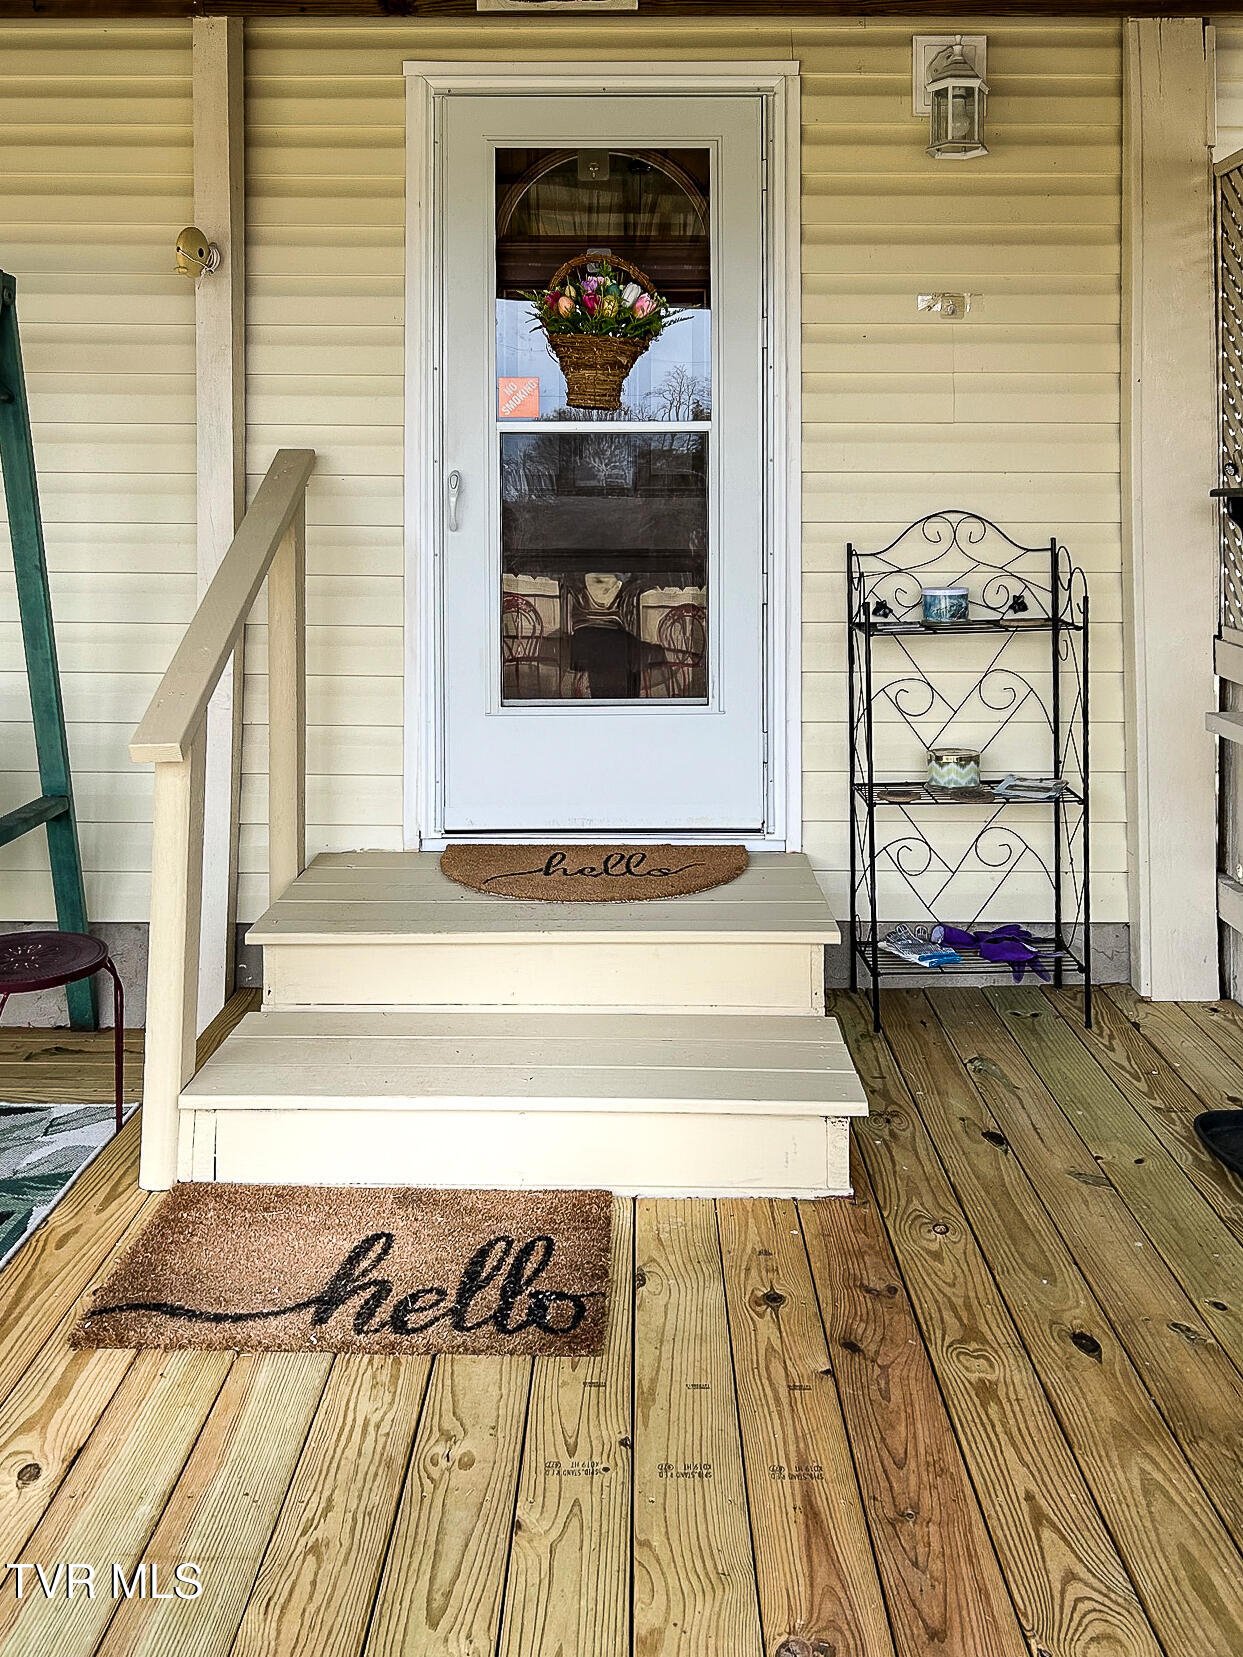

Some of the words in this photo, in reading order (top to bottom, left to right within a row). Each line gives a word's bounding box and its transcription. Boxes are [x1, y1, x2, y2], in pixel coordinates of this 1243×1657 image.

[501, 380, 537, 416] SMOKING
[503, 382, 518, 396] NO
[534, 851, 692, 878] hello
[296, 1231, 606, 1335] hello
